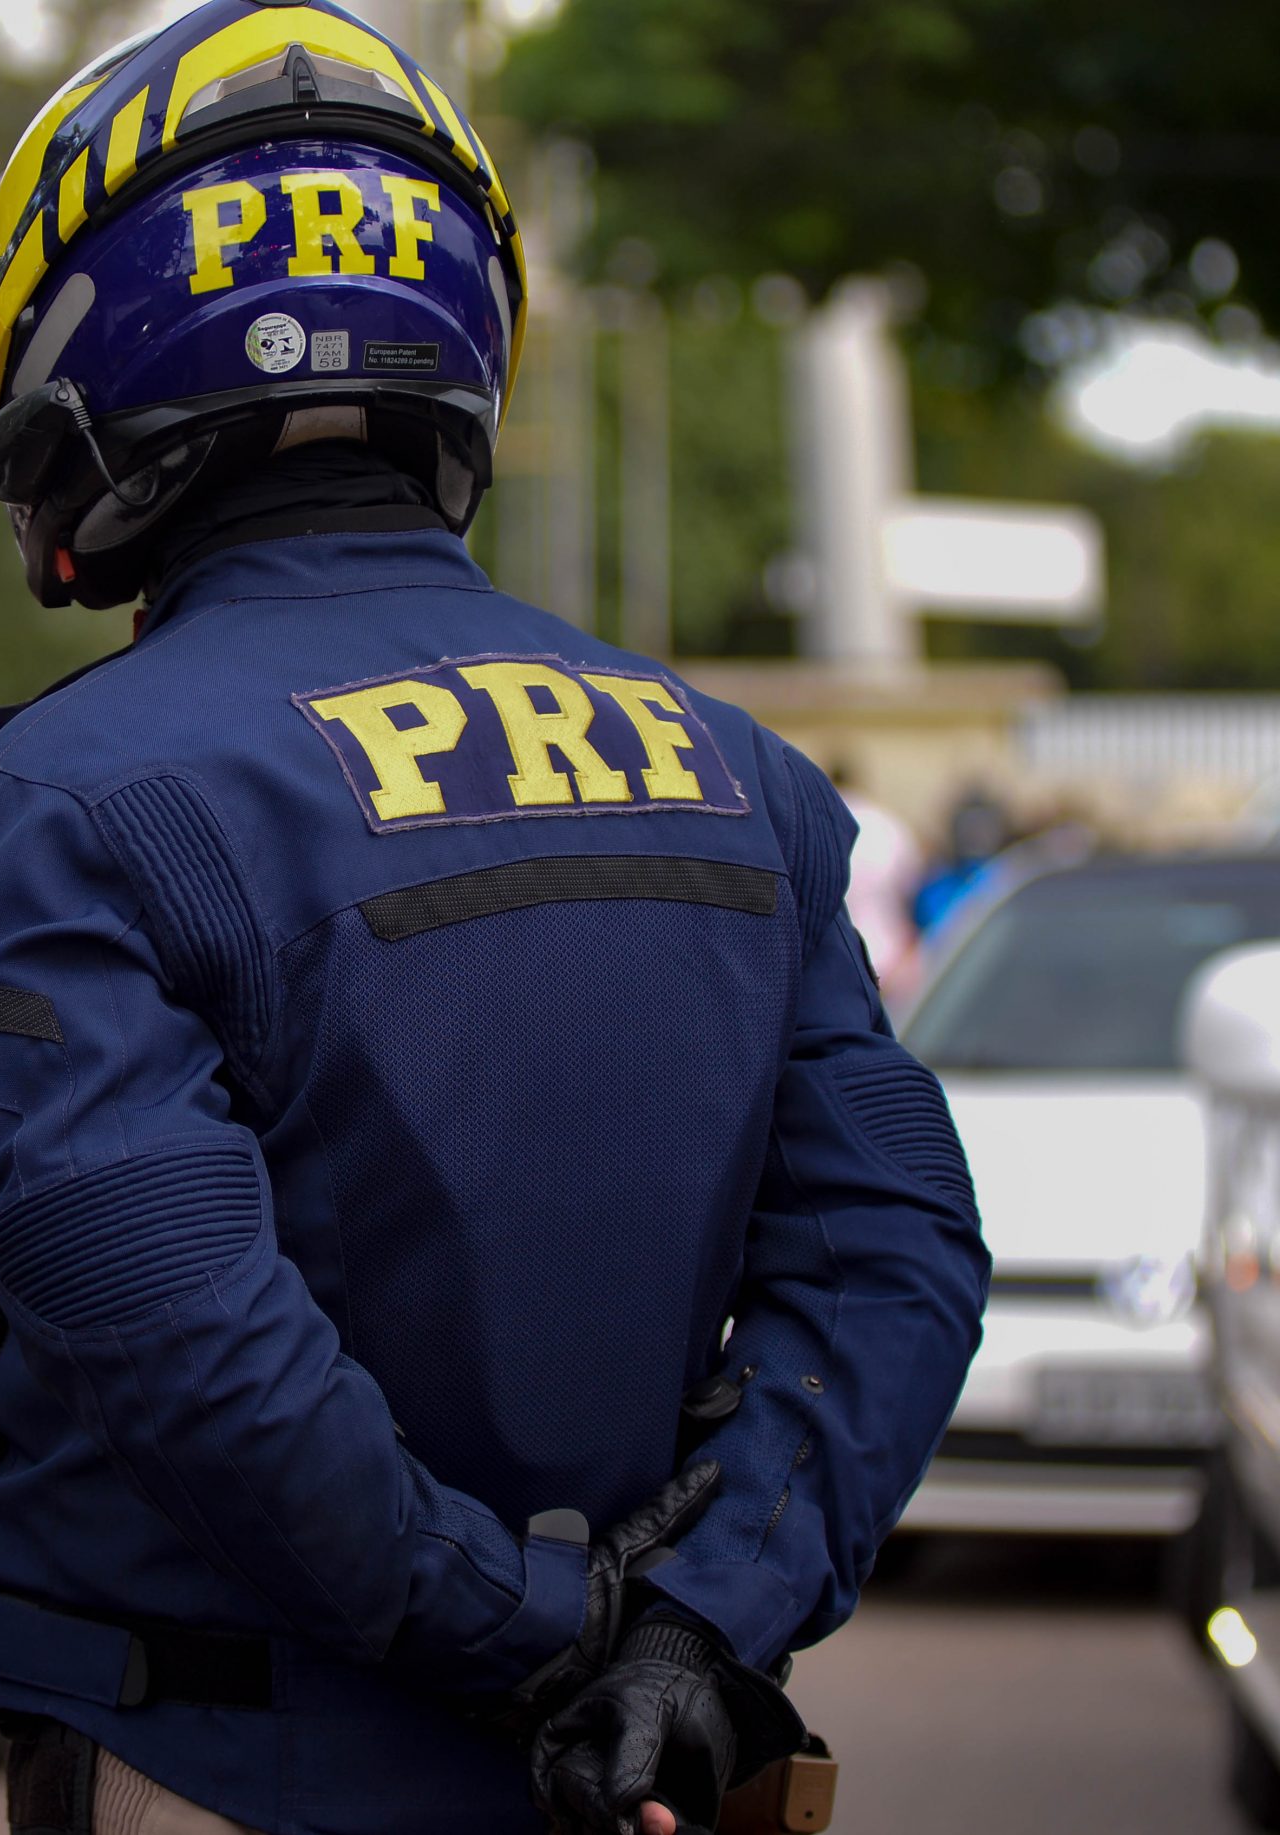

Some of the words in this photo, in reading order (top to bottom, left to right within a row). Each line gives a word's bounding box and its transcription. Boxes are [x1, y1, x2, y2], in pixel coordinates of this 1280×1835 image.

[182, 172, 441, 295] PRF
[315, 342, 343, 350] 7471
[369, 348, 398, 356] European
[398, 348, 417, 356] Patent
[319, 357, 342, 368] 58
[368, 356, 378, 364] No.
[413, 357, 435, 366] pending
[308, 662, 704, 821] PRF
